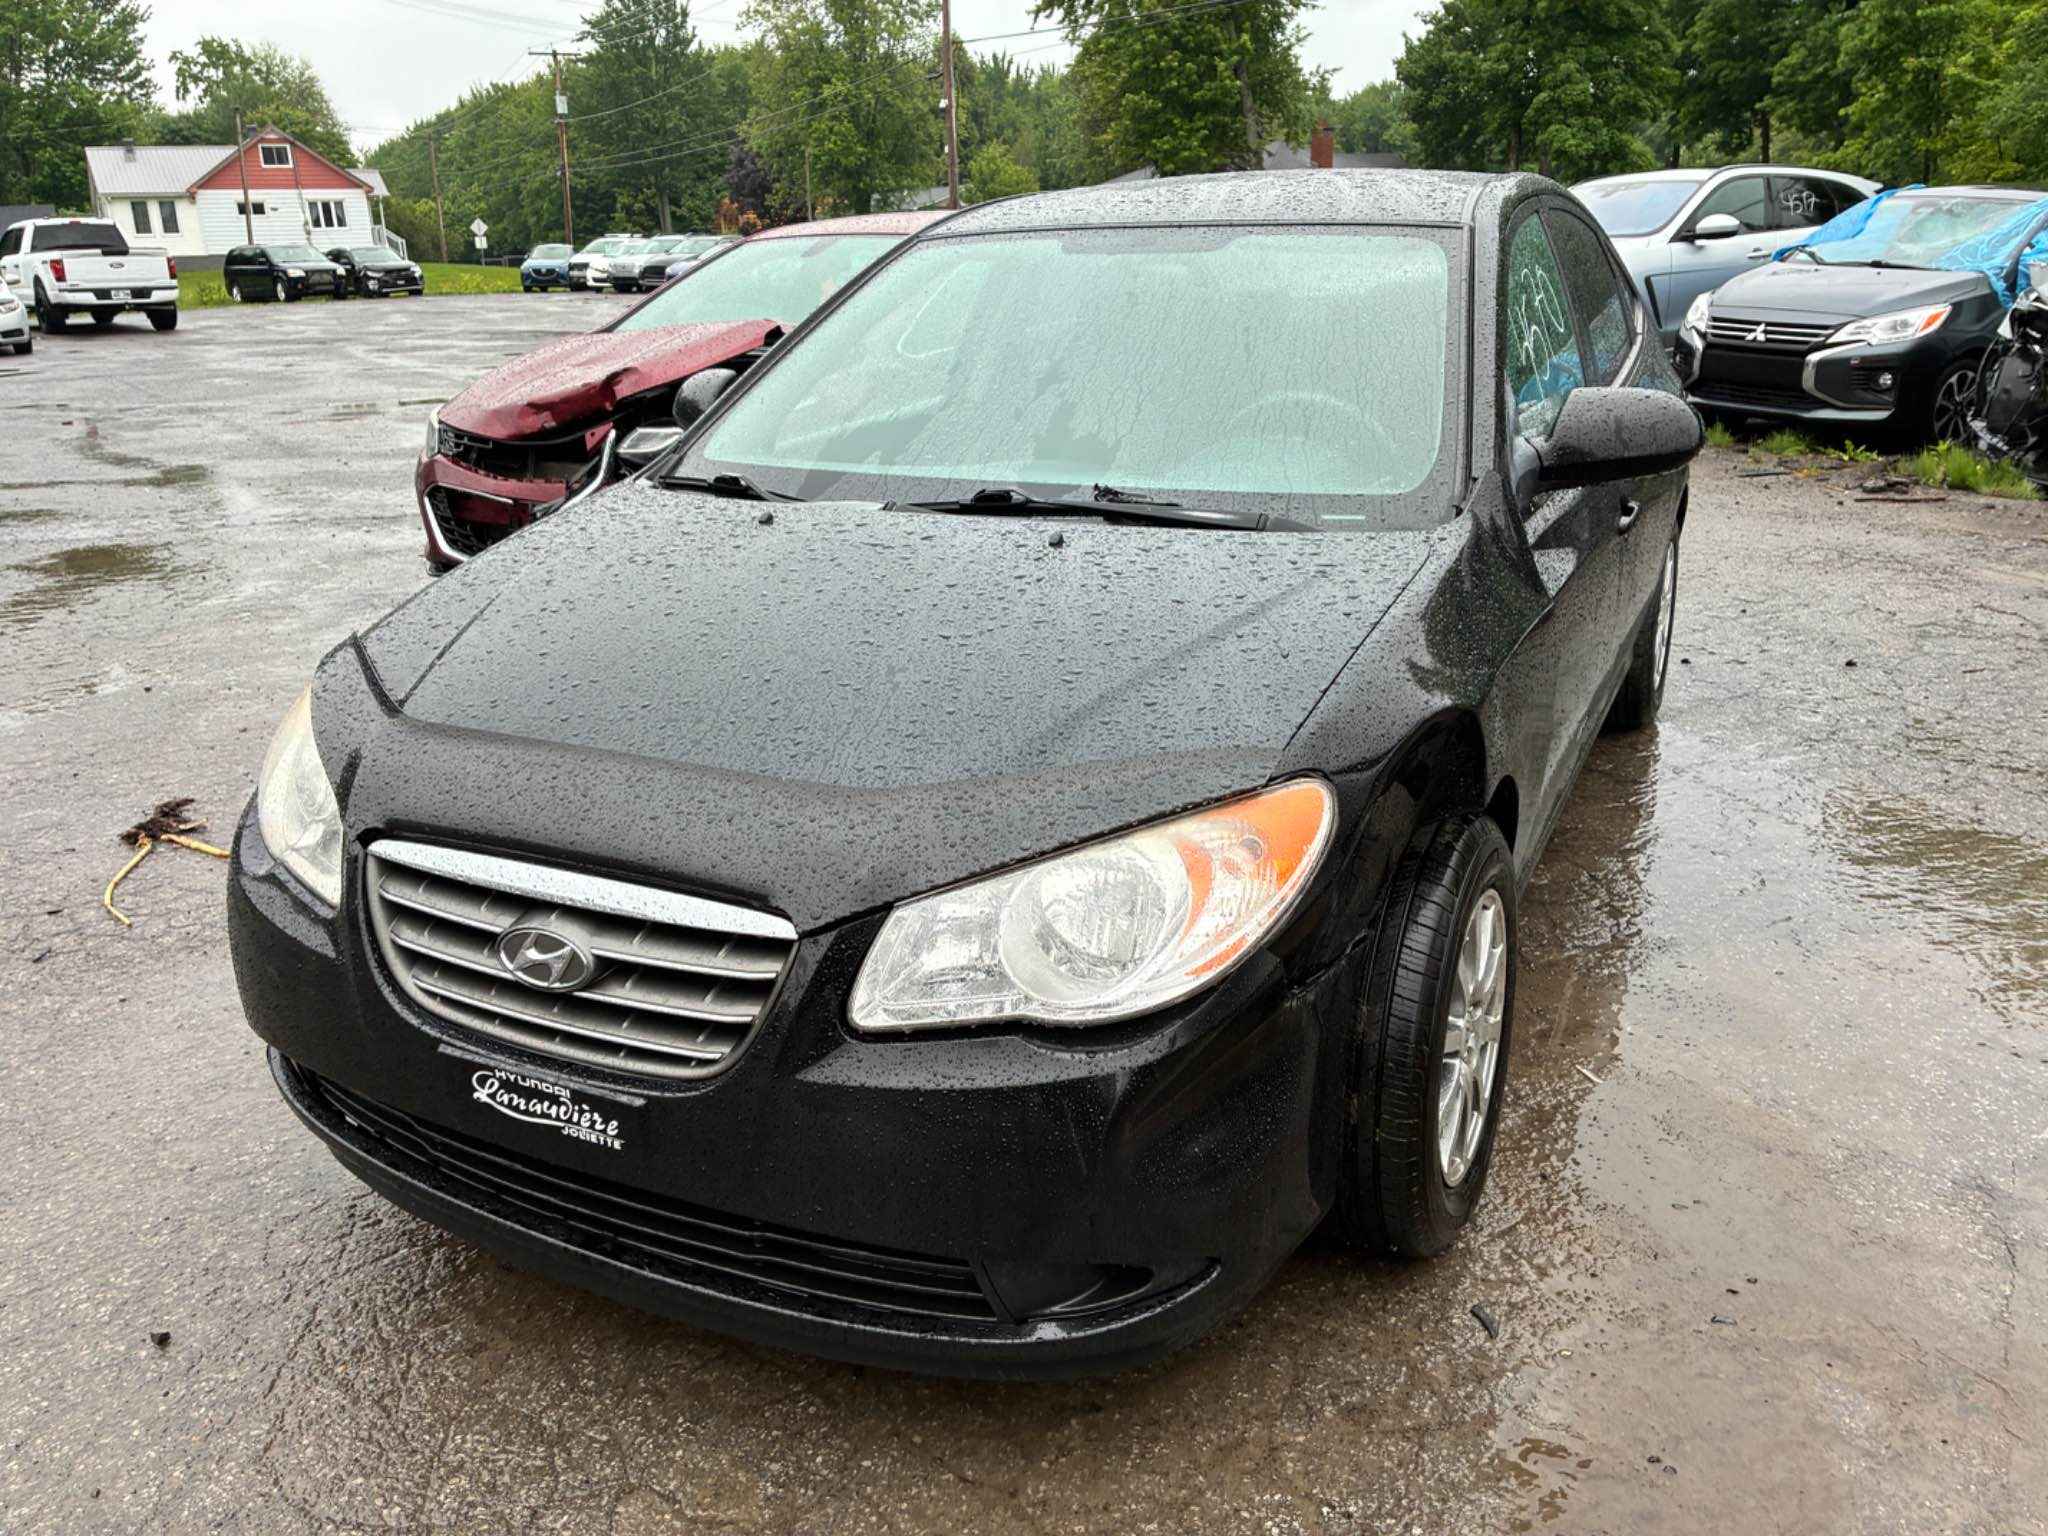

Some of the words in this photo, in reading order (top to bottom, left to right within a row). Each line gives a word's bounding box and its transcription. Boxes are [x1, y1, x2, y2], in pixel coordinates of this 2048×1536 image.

[494, 1068, 571, 1099] HYUNDAI
[471, 1070, 620, 1136] Lanaudière
[561, 1126, 625, 1150] JOLIETTE
